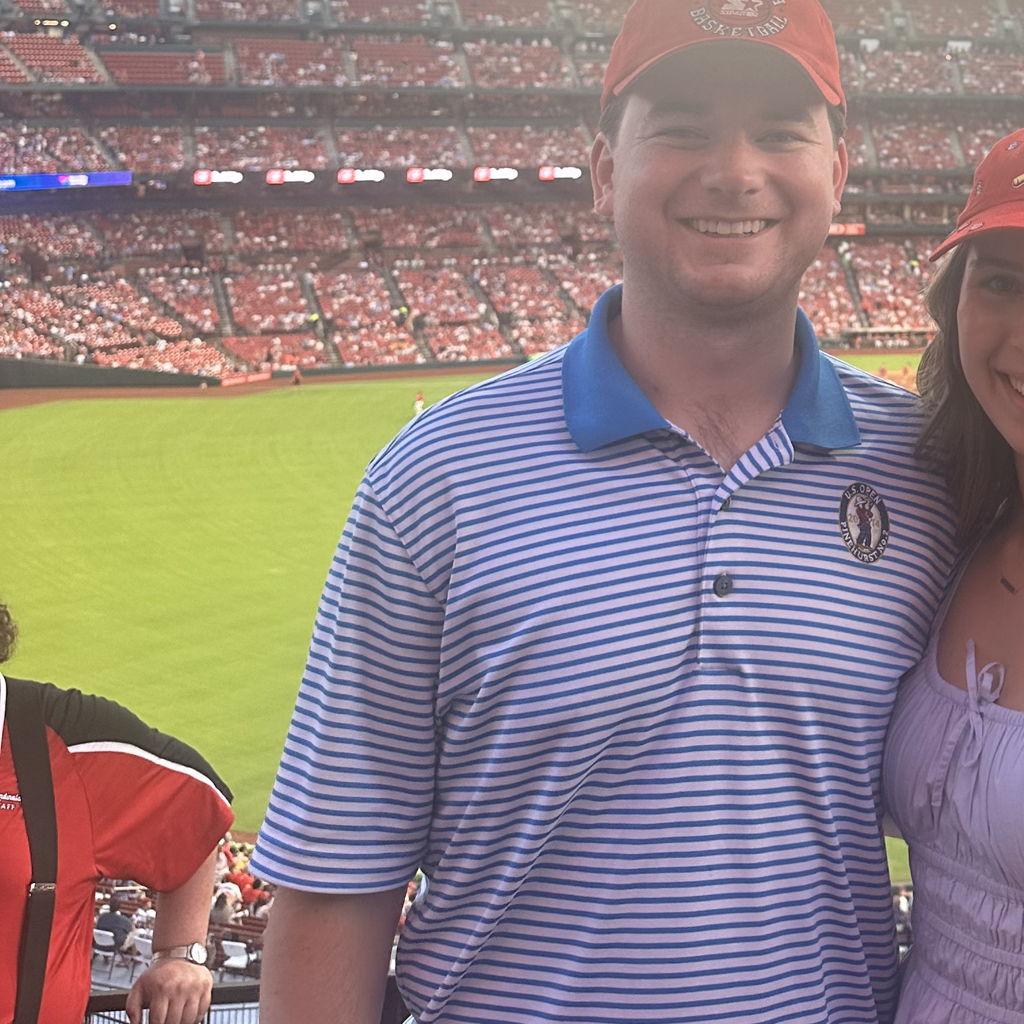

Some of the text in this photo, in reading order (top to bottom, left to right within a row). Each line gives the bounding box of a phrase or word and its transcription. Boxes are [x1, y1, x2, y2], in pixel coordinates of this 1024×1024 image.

[690, 7, 788, 36] BASKETBALL
[860, 484, 881, 504] OPEN
[841, 521, 878, 562] PINEHURST
